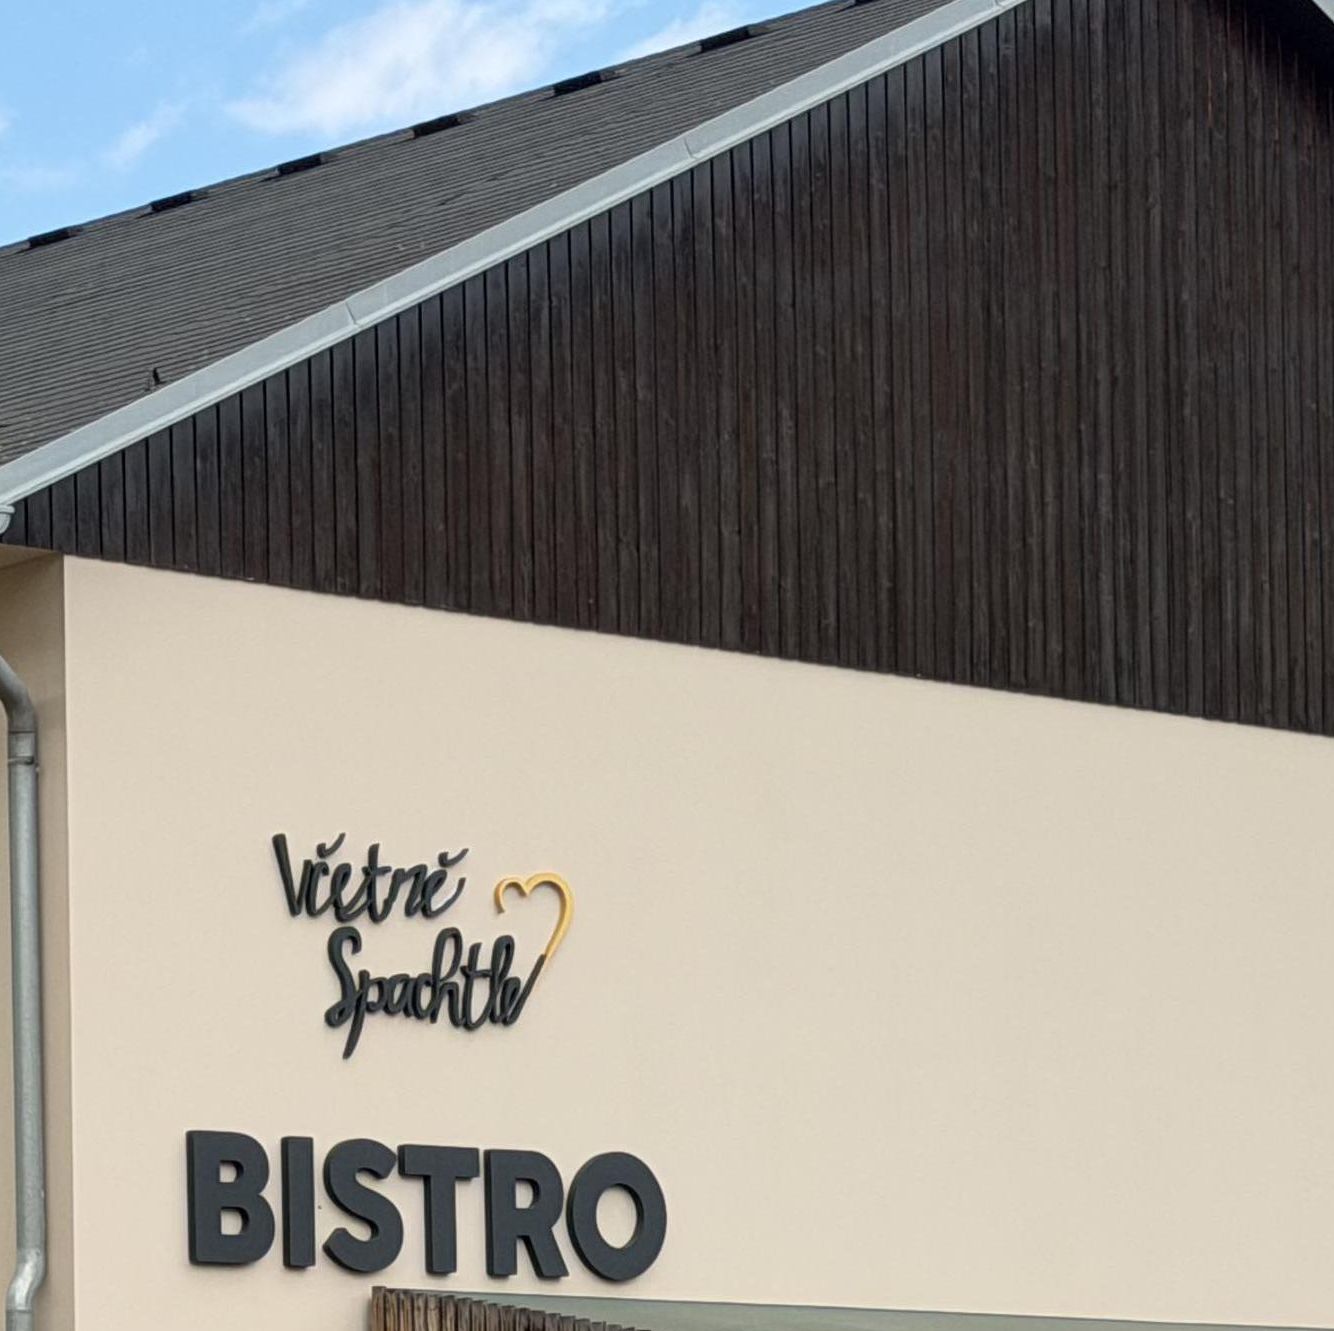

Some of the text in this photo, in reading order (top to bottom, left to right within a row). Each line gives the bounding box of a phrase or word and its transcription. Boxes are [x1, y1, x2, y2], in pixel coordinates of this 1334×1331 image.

[272, 832, 469, 923] Včetně
[324, 926, 546, 1060] Spachtle
[186, 1130, 668, 1282] BISTRO
